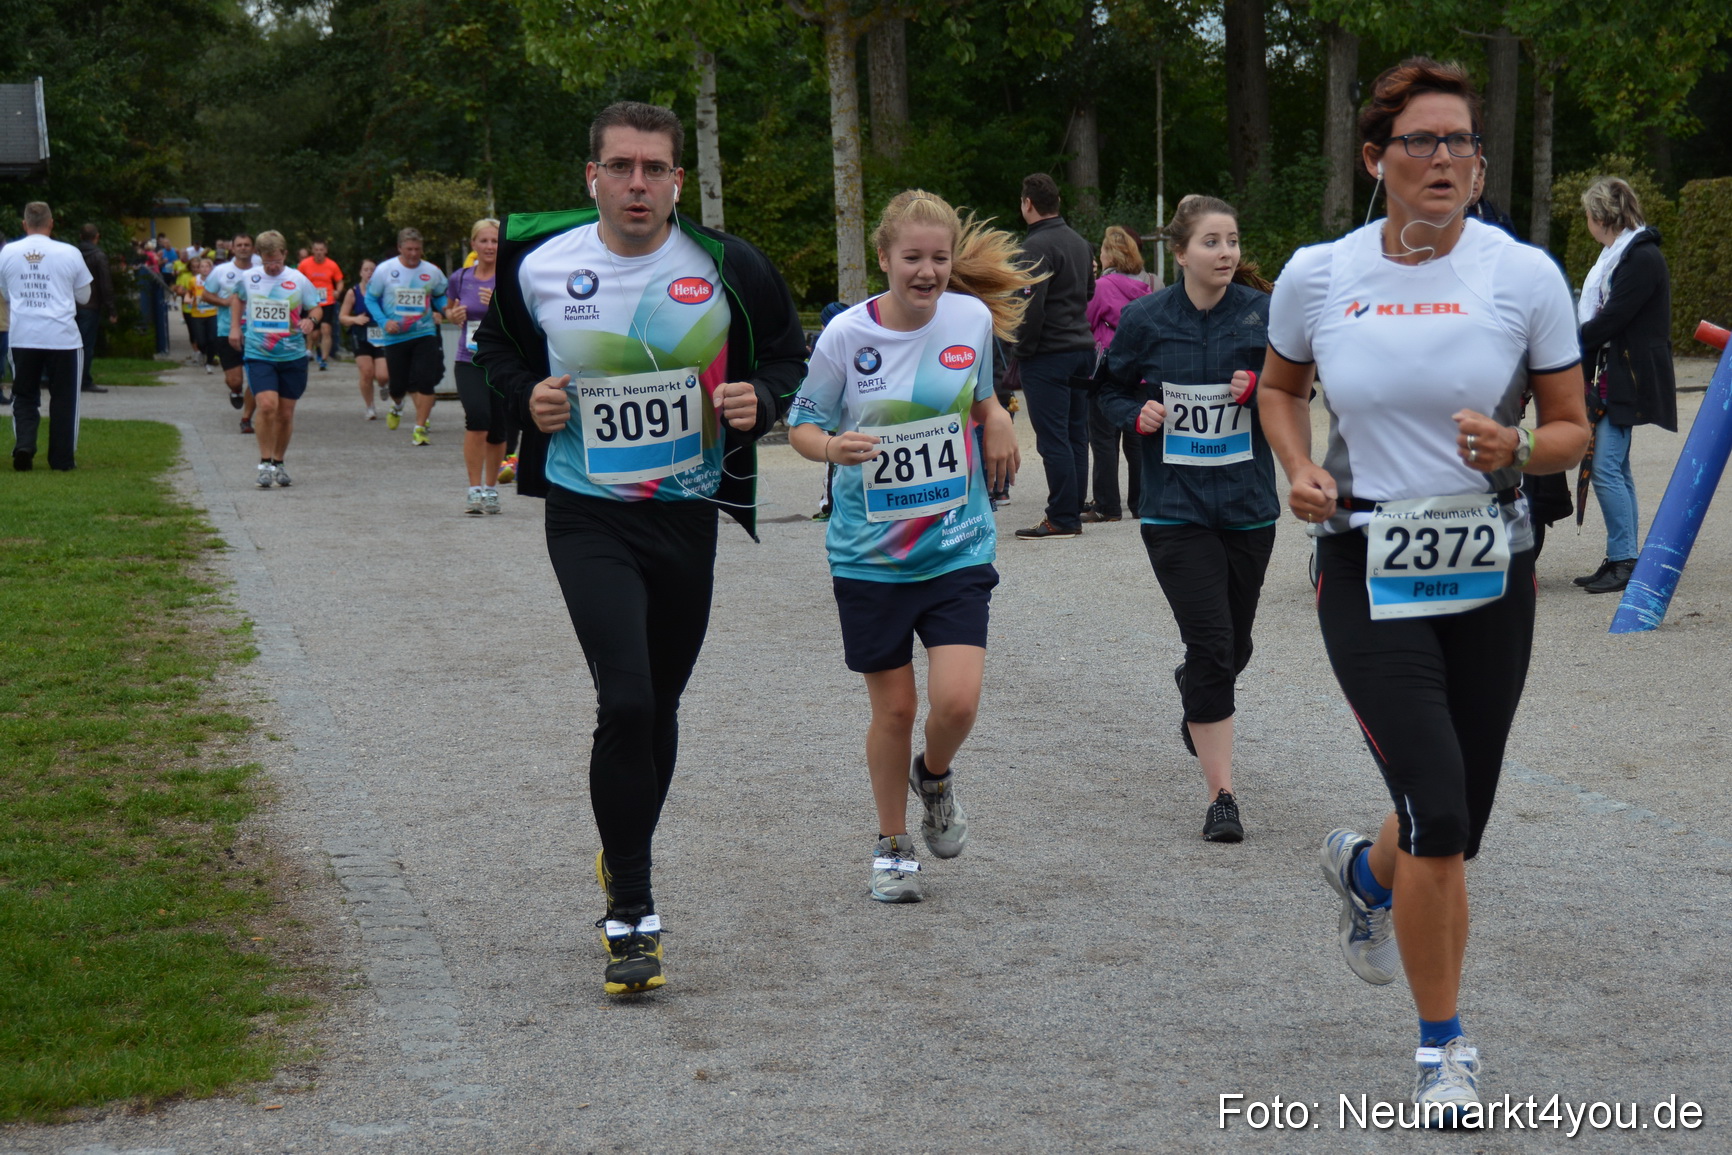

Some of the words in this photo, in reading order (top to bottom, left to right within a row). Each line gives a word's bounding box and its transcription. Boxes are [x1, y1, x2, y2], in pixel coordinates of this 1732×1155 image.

[20, 273, 51, 281] AUFTRAG
[24, 282, 48, 290] SEINER
[674, 284, 709, 297] Hervis
[26, 300, 47, 309] JESUS
[398, 294, 424, 306] 2212
[255, 306, 286, 320] 2525
[564, 304, 600, 314] PARTL
[1376, 303, 1469, 315] KLEBL
[564, 313, 600, 321] Neumarkt
[944, 351, 973, 364] Hervis
[581, 387, 620, 398] PARTL
[623, 381, 681, 396] Neumarkt
[857, 377, 886, 389] PARTL
[858, 384, 887, 394] Neumarkt
[1165, 390, 1192, 401] PARTL
[1194, 391, 1234, 402] Neumark
[594, 394, 689, 442] 3091
[1173, 402, 1243, 434] 2077
[896, 427, 944, 443] Neumarkt
[1191, 441, 1227, 454] Hanna
[872, 439, 958, 485] 2814
[886, 486, 950, 507] Franziska
[1423, 507, 1484, 520] Neumarkt
[1383, 524, 1496, 571] 2372
[1413, 581, 1459, 598] Petra
